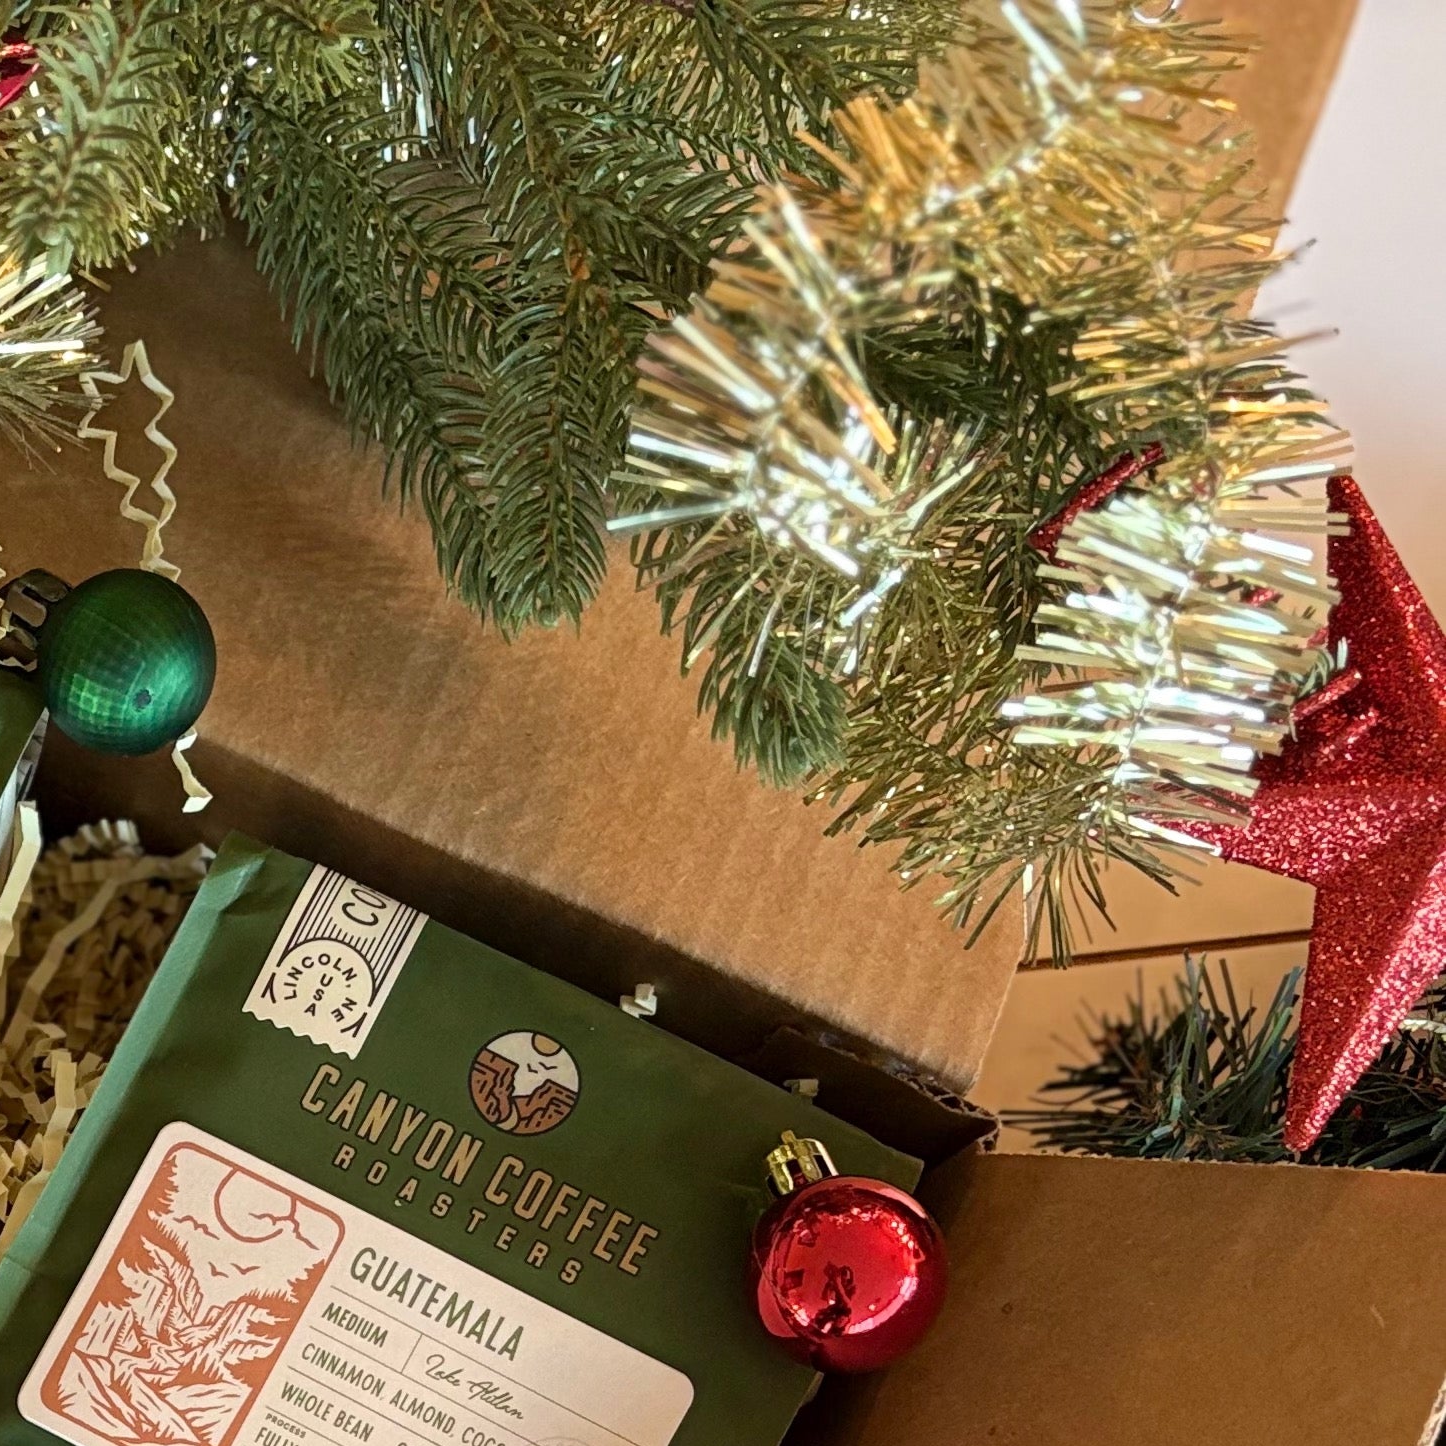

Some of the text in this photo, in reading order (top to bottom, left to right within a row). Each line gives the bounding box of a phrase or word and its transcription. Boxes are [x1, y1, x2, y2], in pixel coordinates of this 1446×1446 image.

[342, 884, 388, 926] CO
[284, 953, 357, 1022] LINCOLN, NE
[299, 1062, 660, 1277] CANYON COFFEE
[332, 1142, 584, 1286] ROASTERS
[321, 1302, 389, 1348] MEDIUM
[350, 1247, 524, 1362] GUATEMALA
[301, 1342, 388, 1399] CINNAMON,
[389, 1389, 456, 1438] ALMOND,
[425, 1353, 464, 1387] Lake
[265, 1413, 307, 1439] PROCESS
[280, 1381, 374, 1443] WHOLE BEAN
